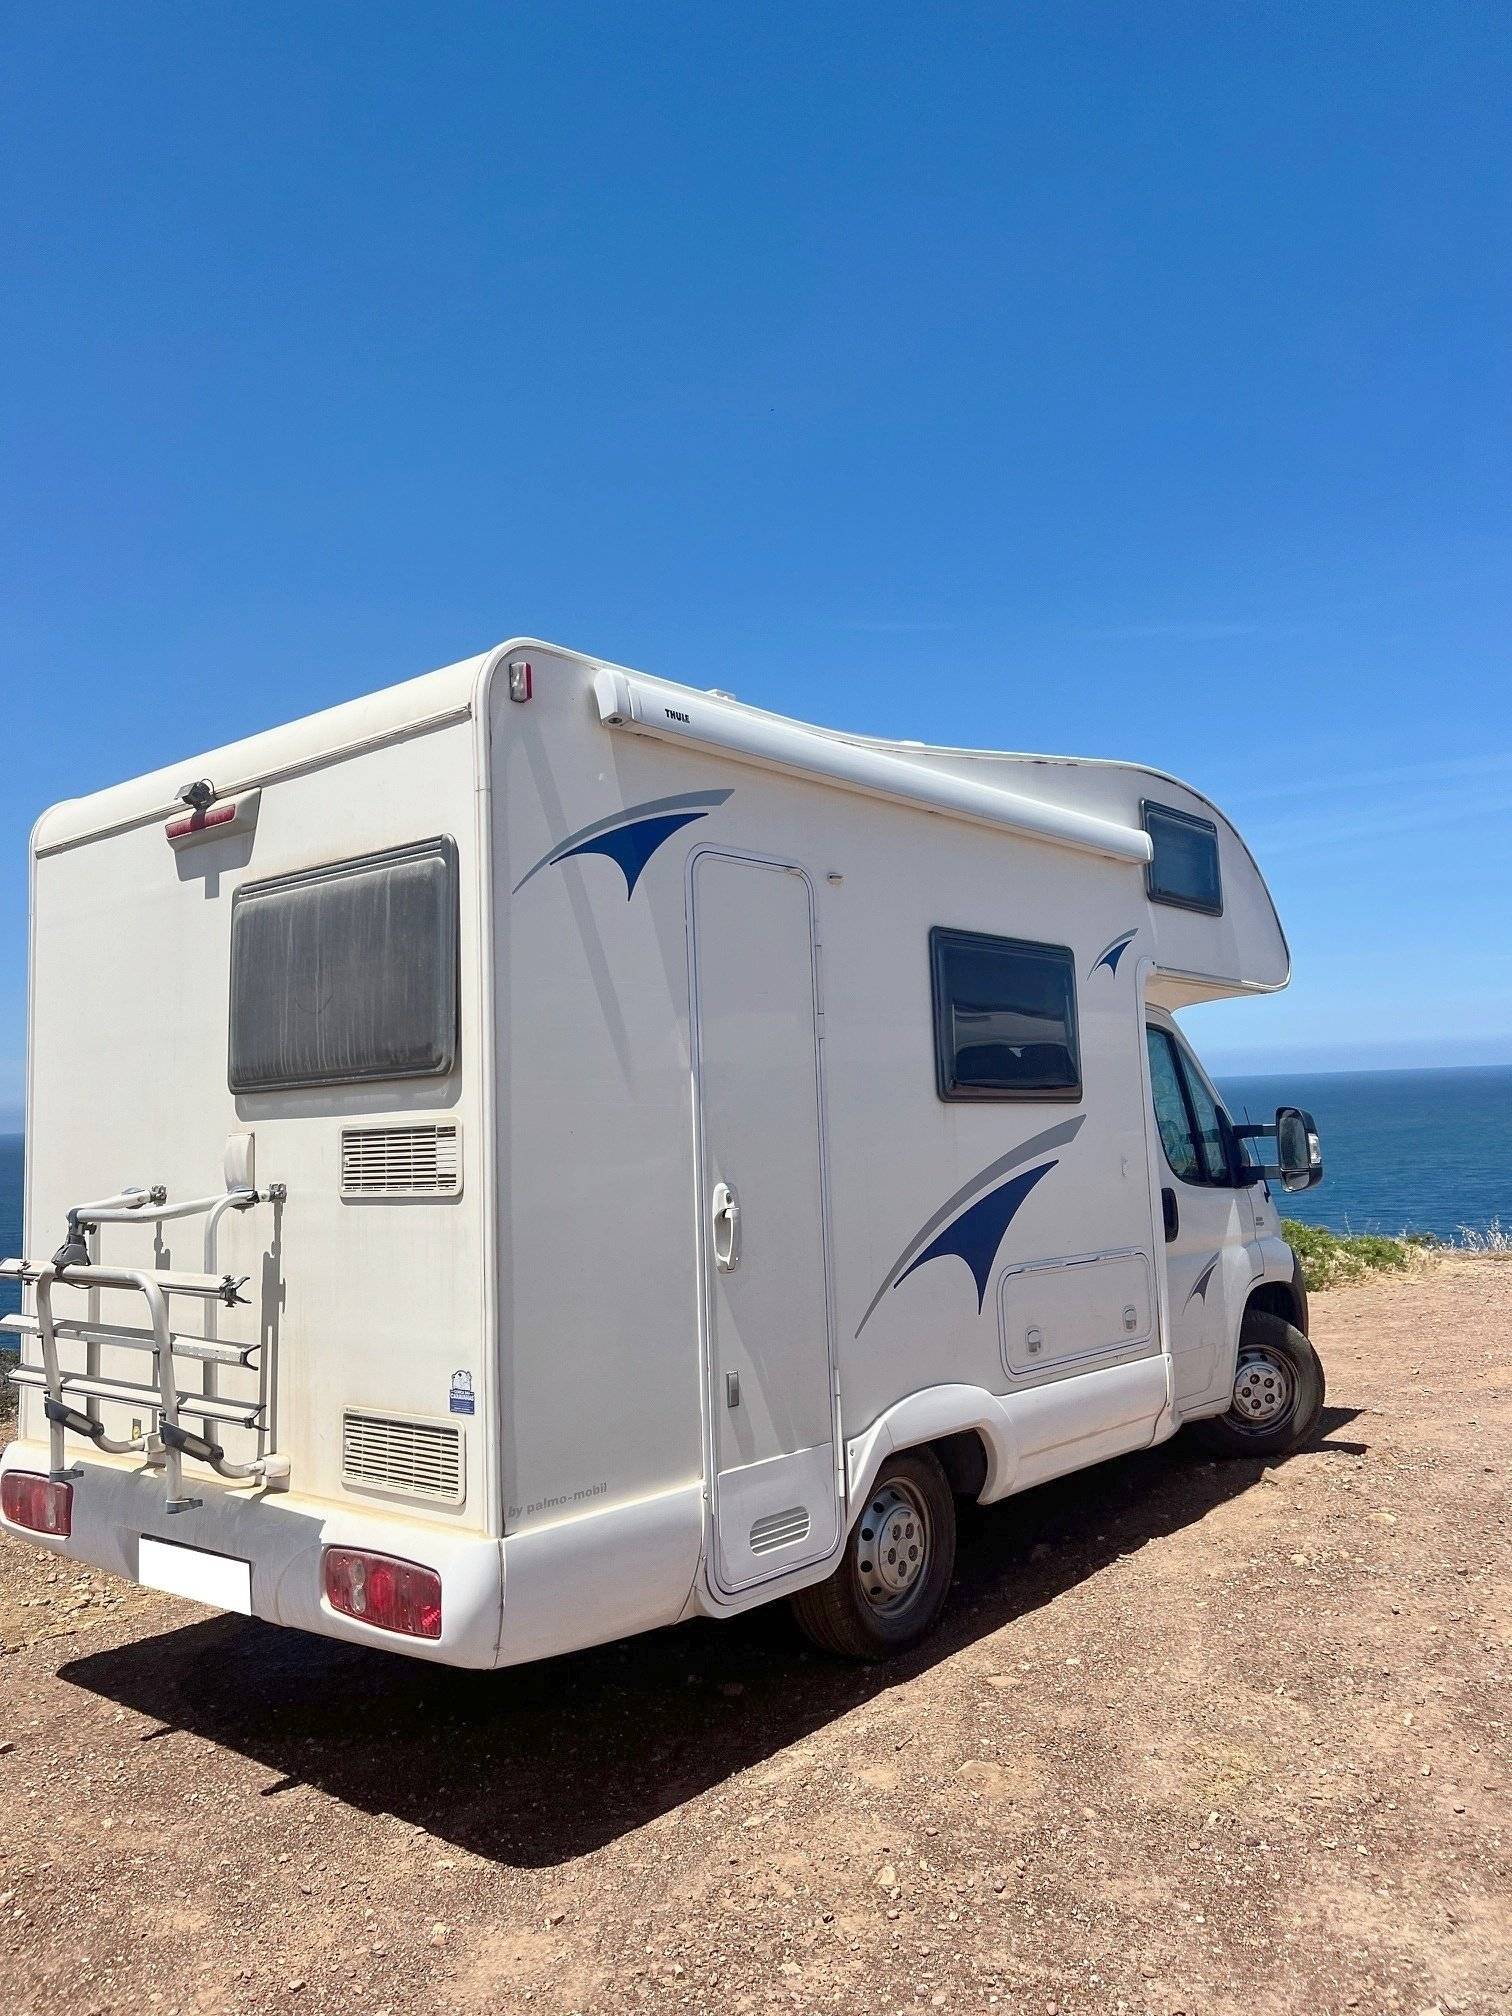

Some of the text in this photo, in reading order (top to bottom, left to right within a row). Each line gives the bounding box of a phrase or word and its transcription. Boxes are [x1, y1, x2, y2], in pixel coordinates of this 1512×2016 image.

[664, 708, 690, 724] THULE
[508, 1482, 607, 1519] by palmo-mobil
